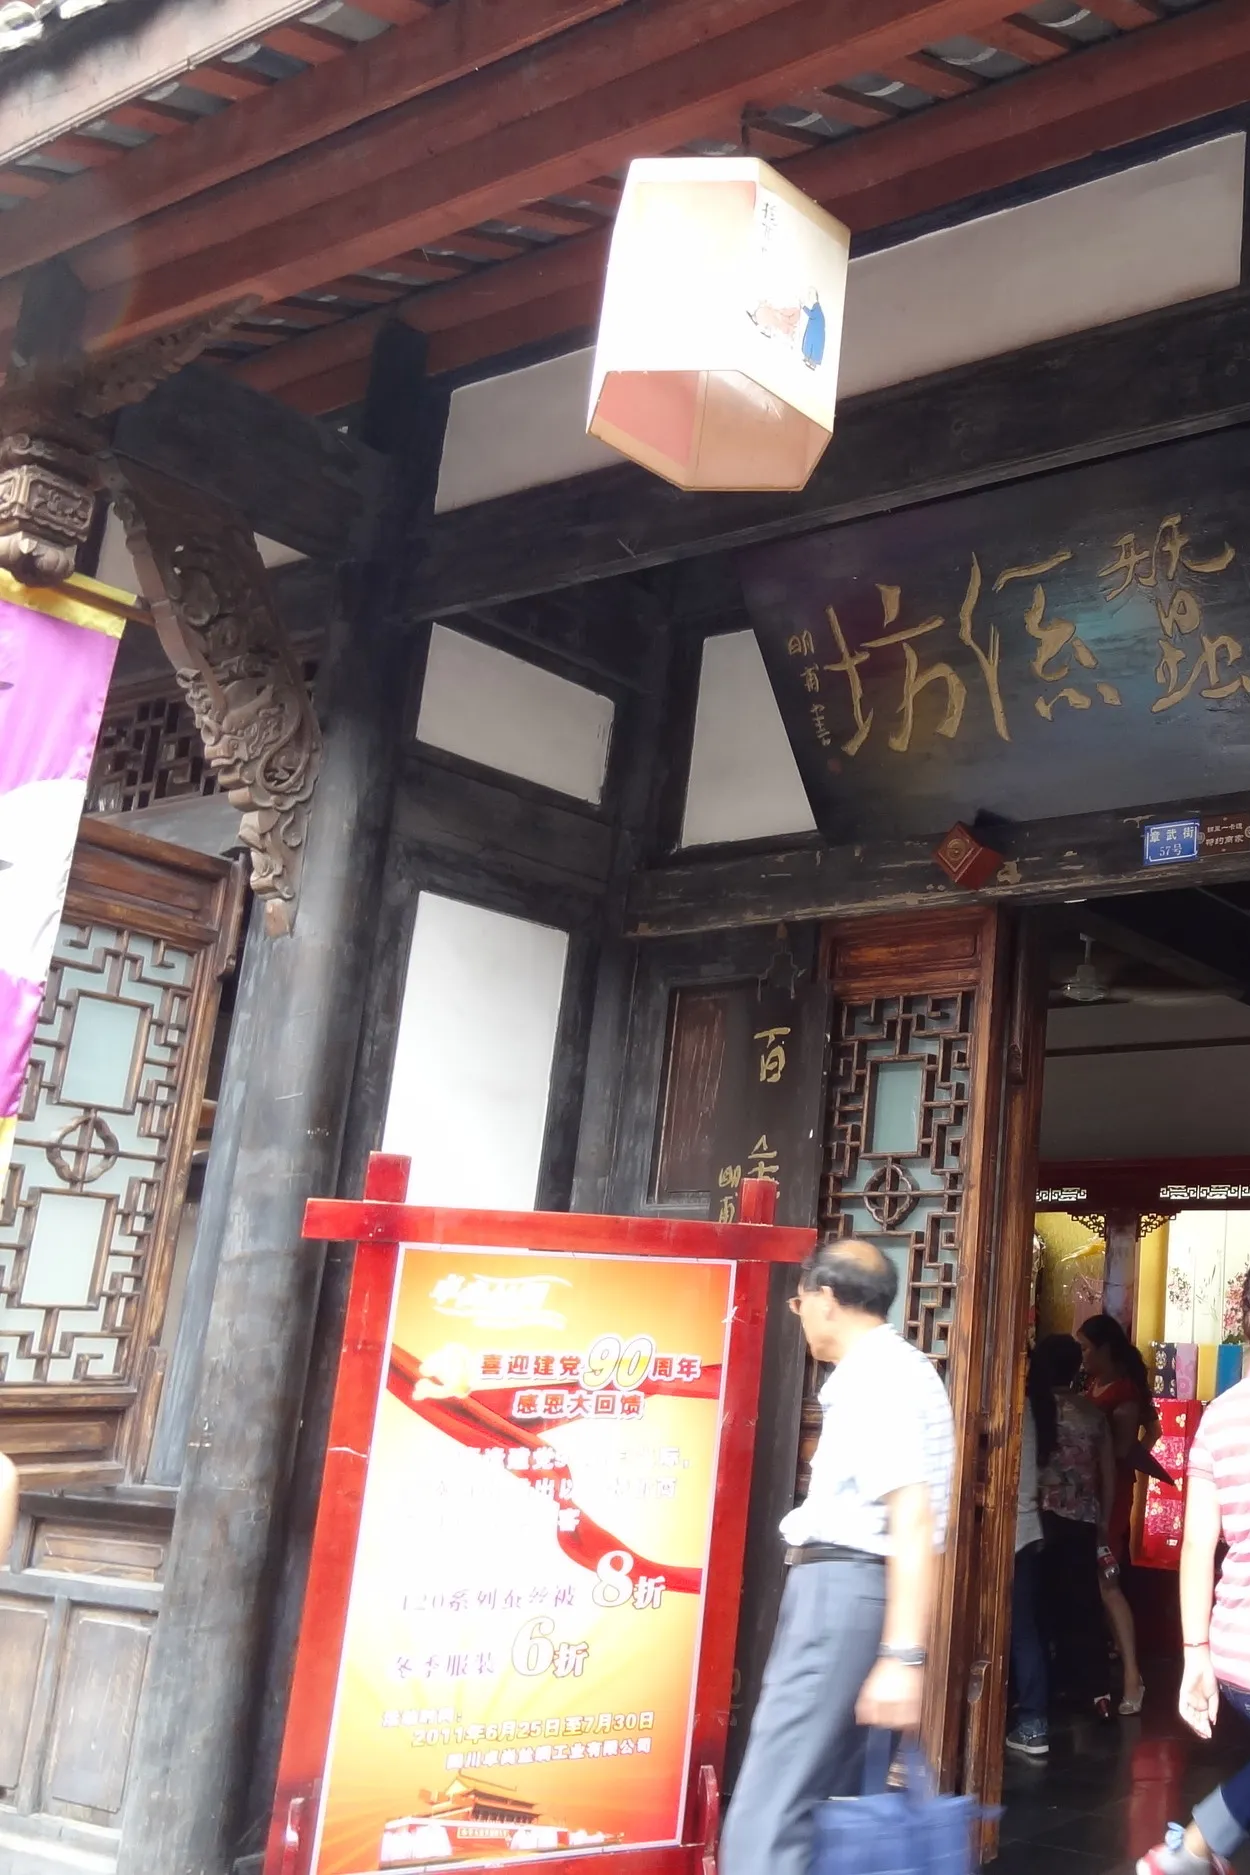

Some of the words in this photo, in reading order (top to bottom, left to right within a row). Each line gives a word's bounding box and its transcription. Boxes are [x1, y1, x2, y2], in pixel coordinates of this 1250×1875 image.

[1149, 826, 1195, 843] 章武街
[1159, 843, 1183, 857] 57号
[480, 1336, 701, 1388] 喜迎建党90周年
[515, 1391, 643, 1417] 感恩大回馈
[591, 1549, 667, 1611] 8折
[510, 1615, 591, 1679] 6折
[411, 1710, 655, 1748] 2011年6月25日至7月30日
